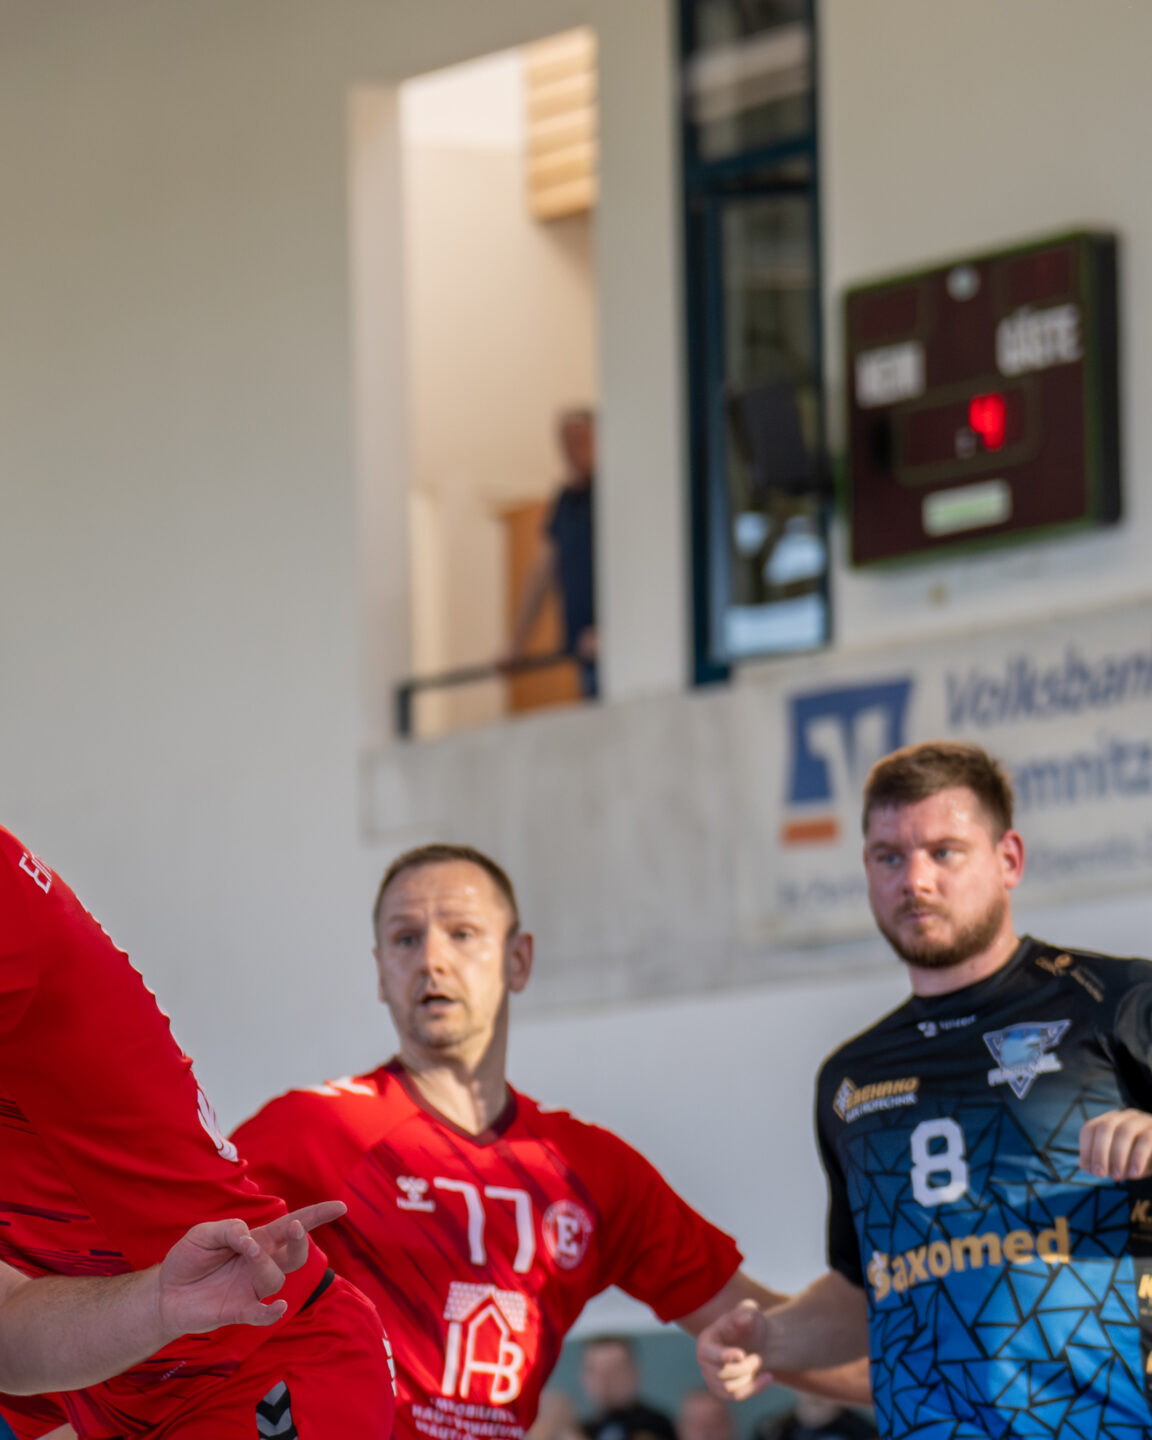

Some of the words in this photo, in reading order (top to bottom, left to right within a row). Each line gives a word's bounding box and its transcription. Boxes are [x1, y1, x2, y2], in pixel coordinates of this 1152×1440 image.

[945, 640, 1152, 732] Volksban
[911, 1117, 969, 1208] 8
[433, 1177, 536, 1274] 77
[866, 1216, 1071, 1302] Saxomed
